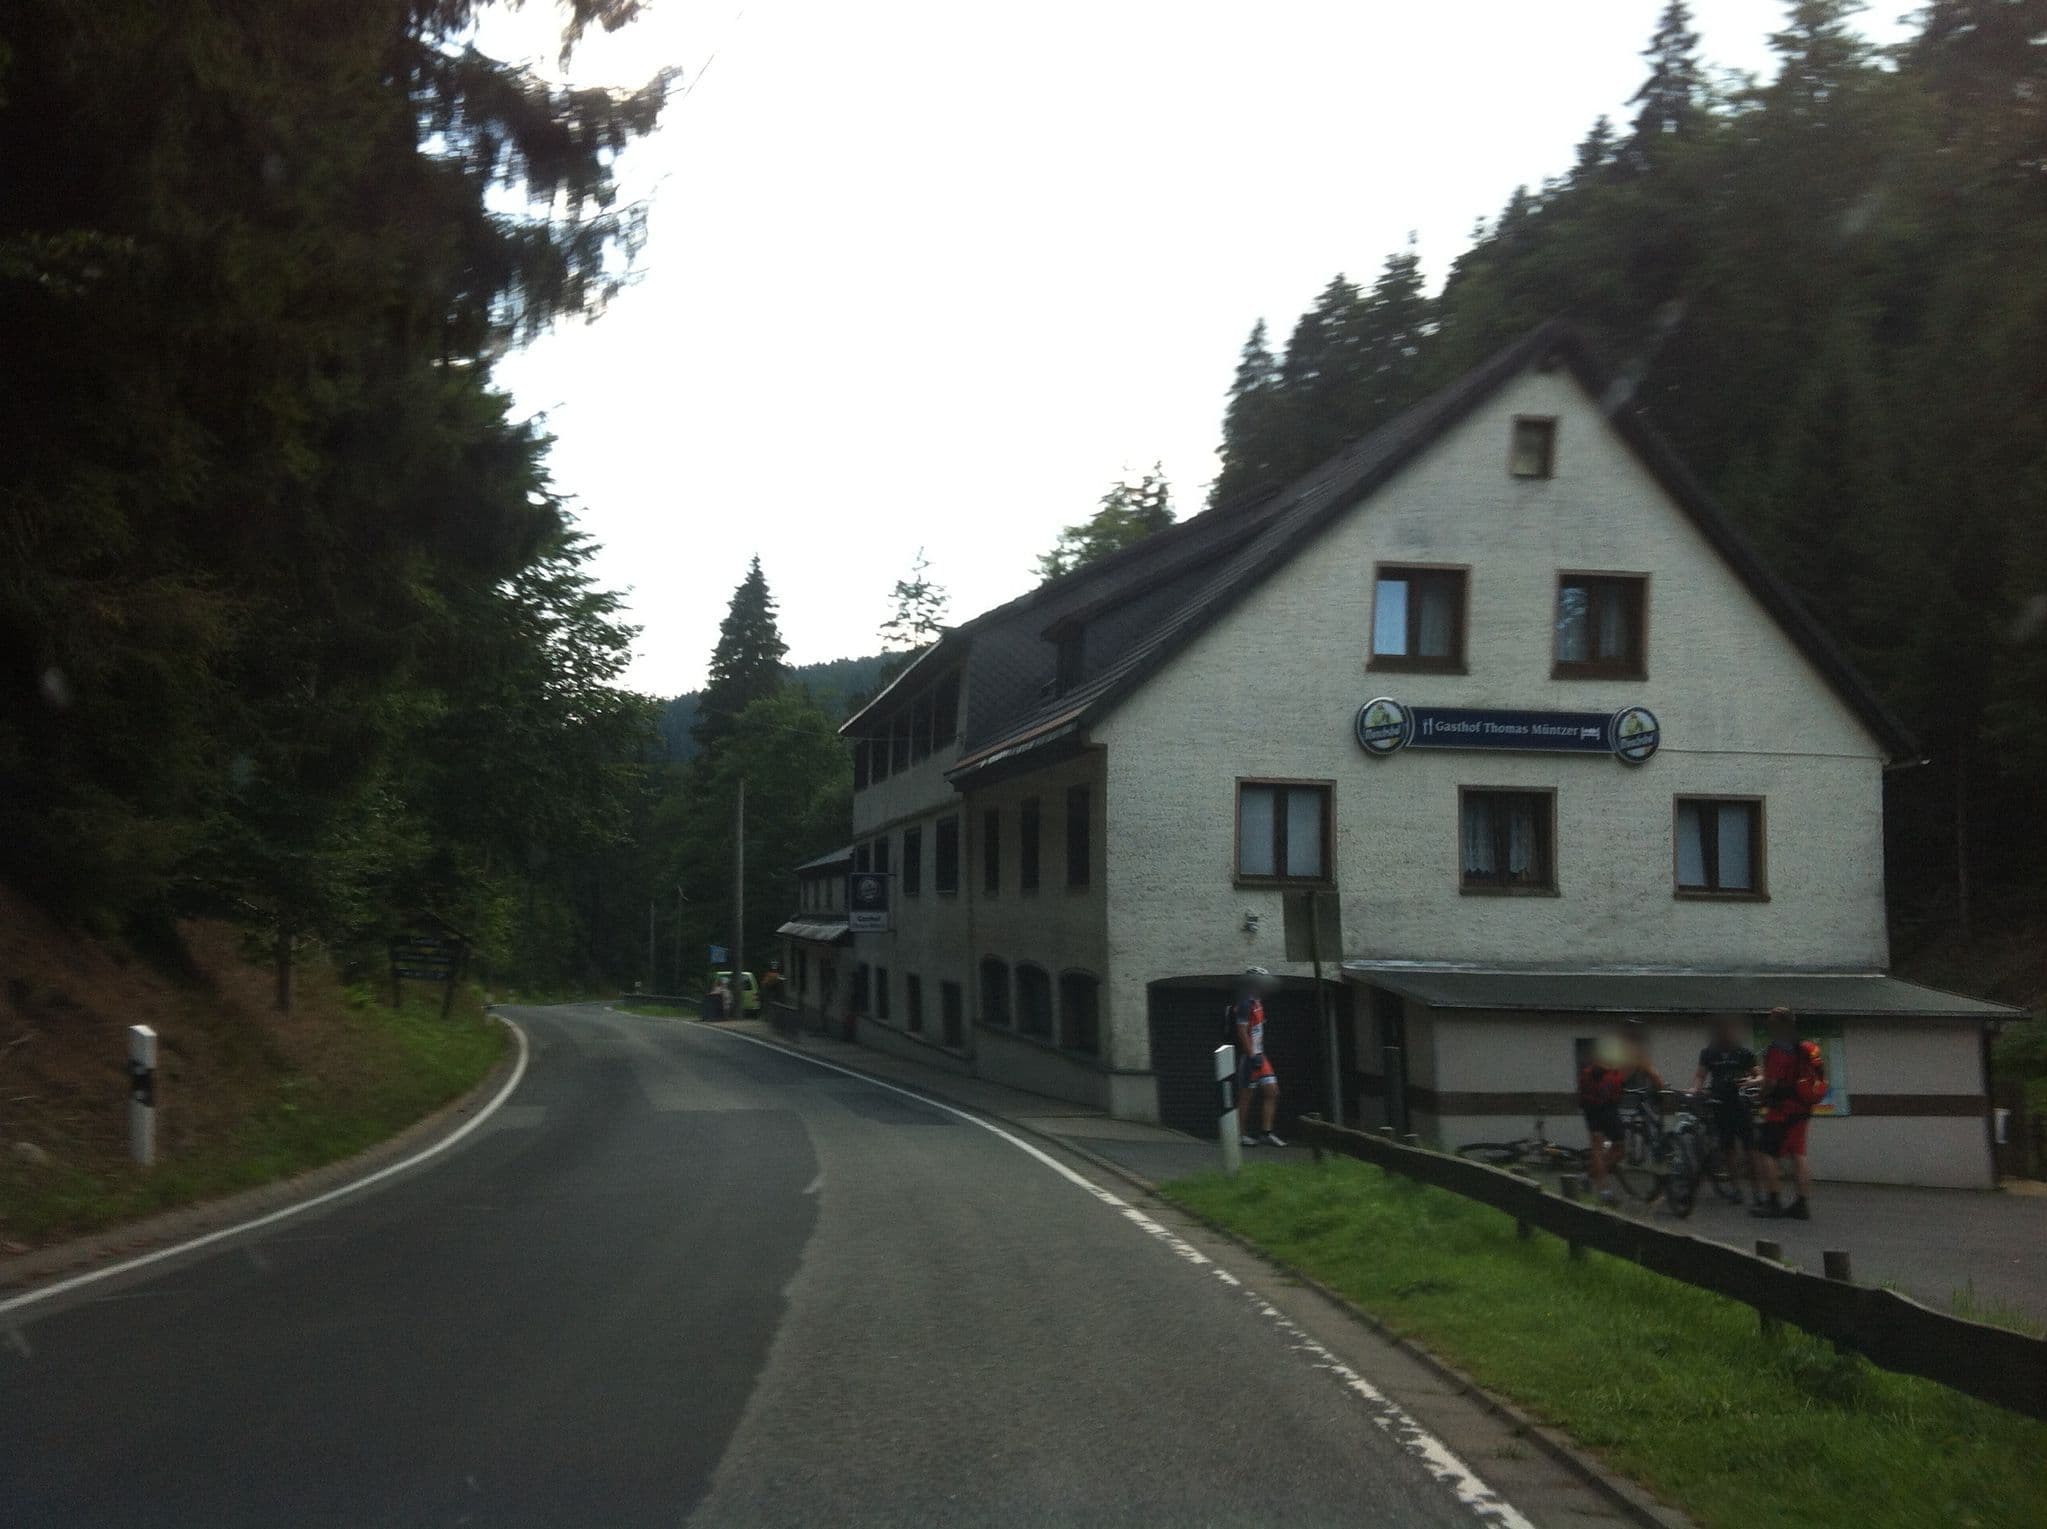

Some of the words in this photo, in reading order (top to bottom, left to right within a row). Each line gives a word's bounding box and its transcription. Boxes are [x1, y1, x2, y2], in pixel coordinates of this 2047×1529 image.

[1434, 720, 1481, 733] Gasthof
[1483, 722, 1528, 735] Thomas
[1531, 723, 1578, 736] Müntzer
